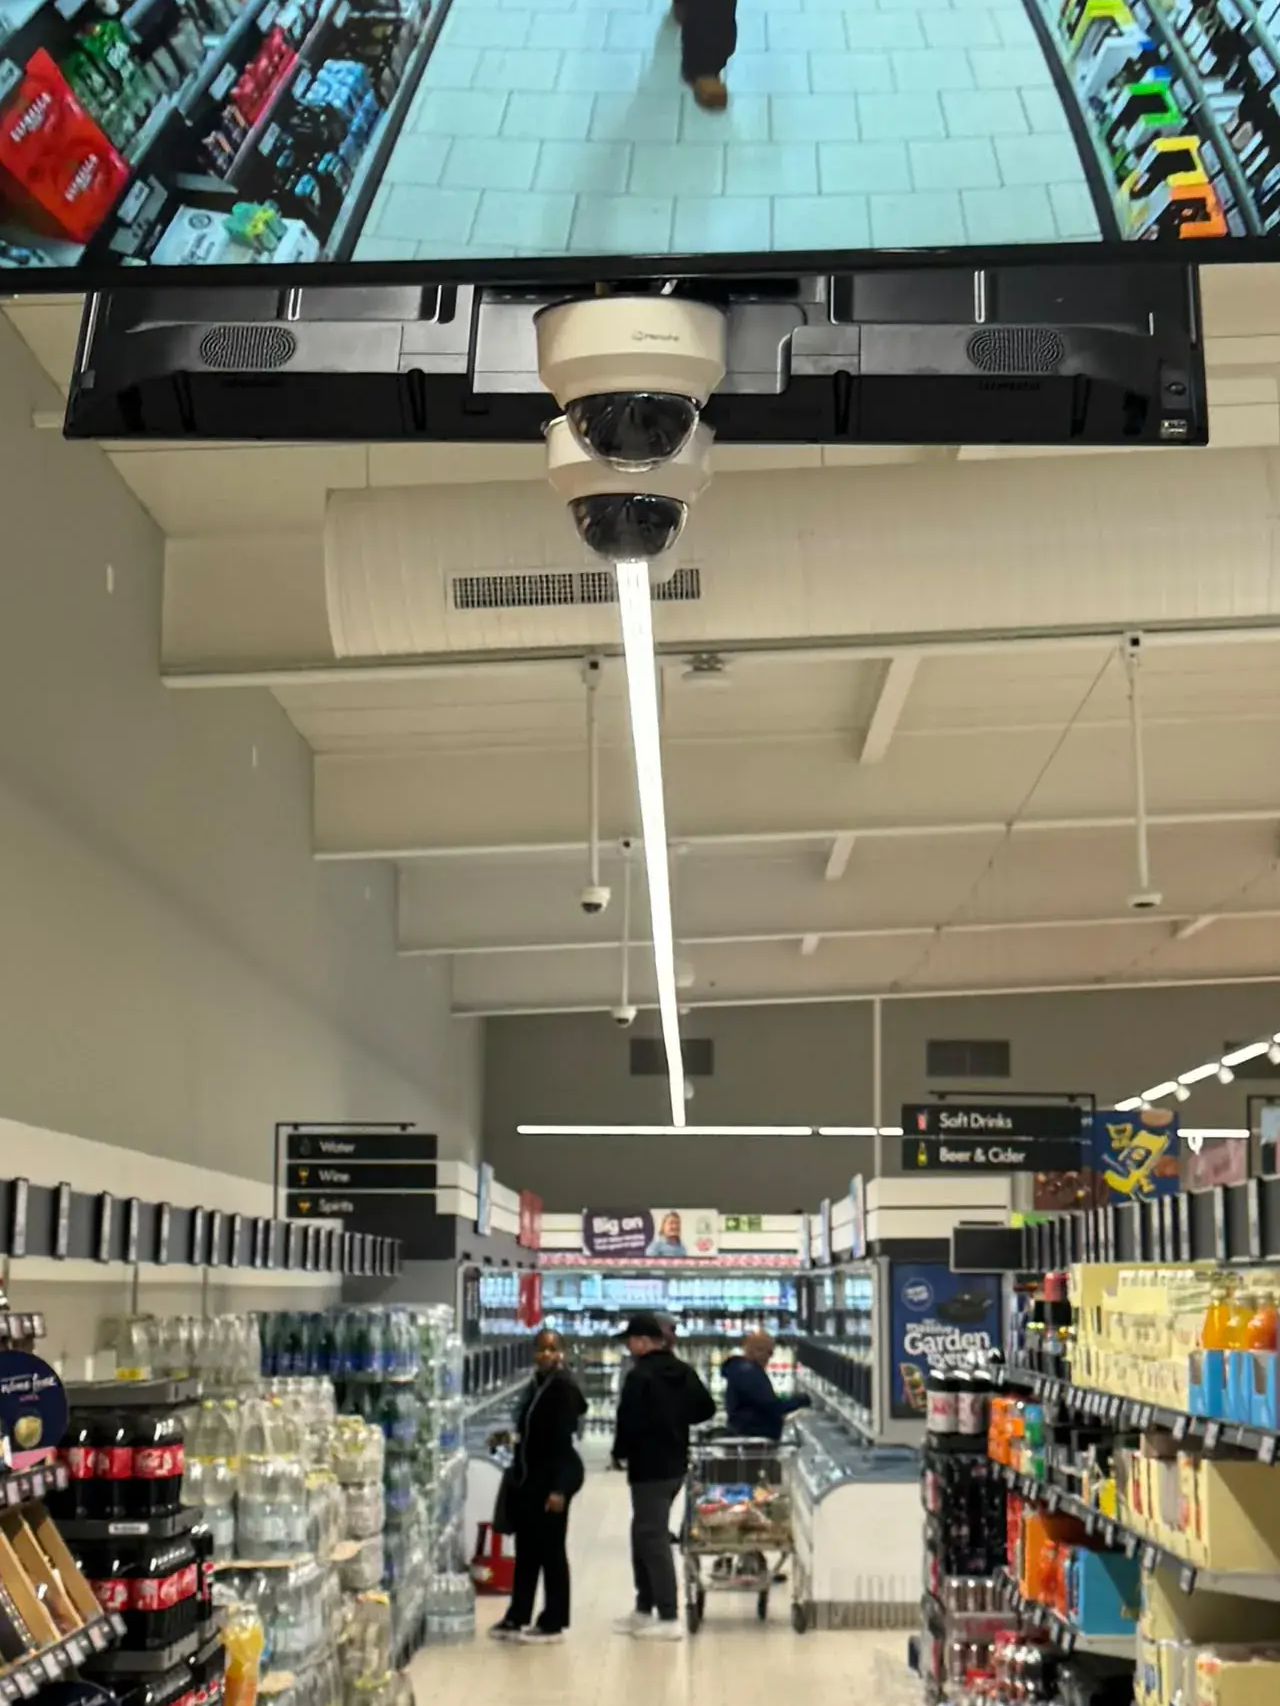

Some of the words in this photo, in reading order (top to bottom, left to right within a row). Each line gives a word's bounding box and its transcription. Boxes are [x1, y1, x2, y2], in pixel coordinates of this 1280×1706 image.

[939, 1113, 968, 1128] Soft
[970, 1112, 1013, 1129] Drinks
[939, 1147, 970, 1162] Beer
[974, 1147, 985, 1163] &
[988, 1145, 1025, 1163] Cider
[318, 1168, 351, 1184] Wine
[318, 1198, 354, 1214] Spirits
[592, 1216, 619, 1236] Big
[621, 1216, 644, 1231] on
[904, 1329, 991, 1356] Garden
